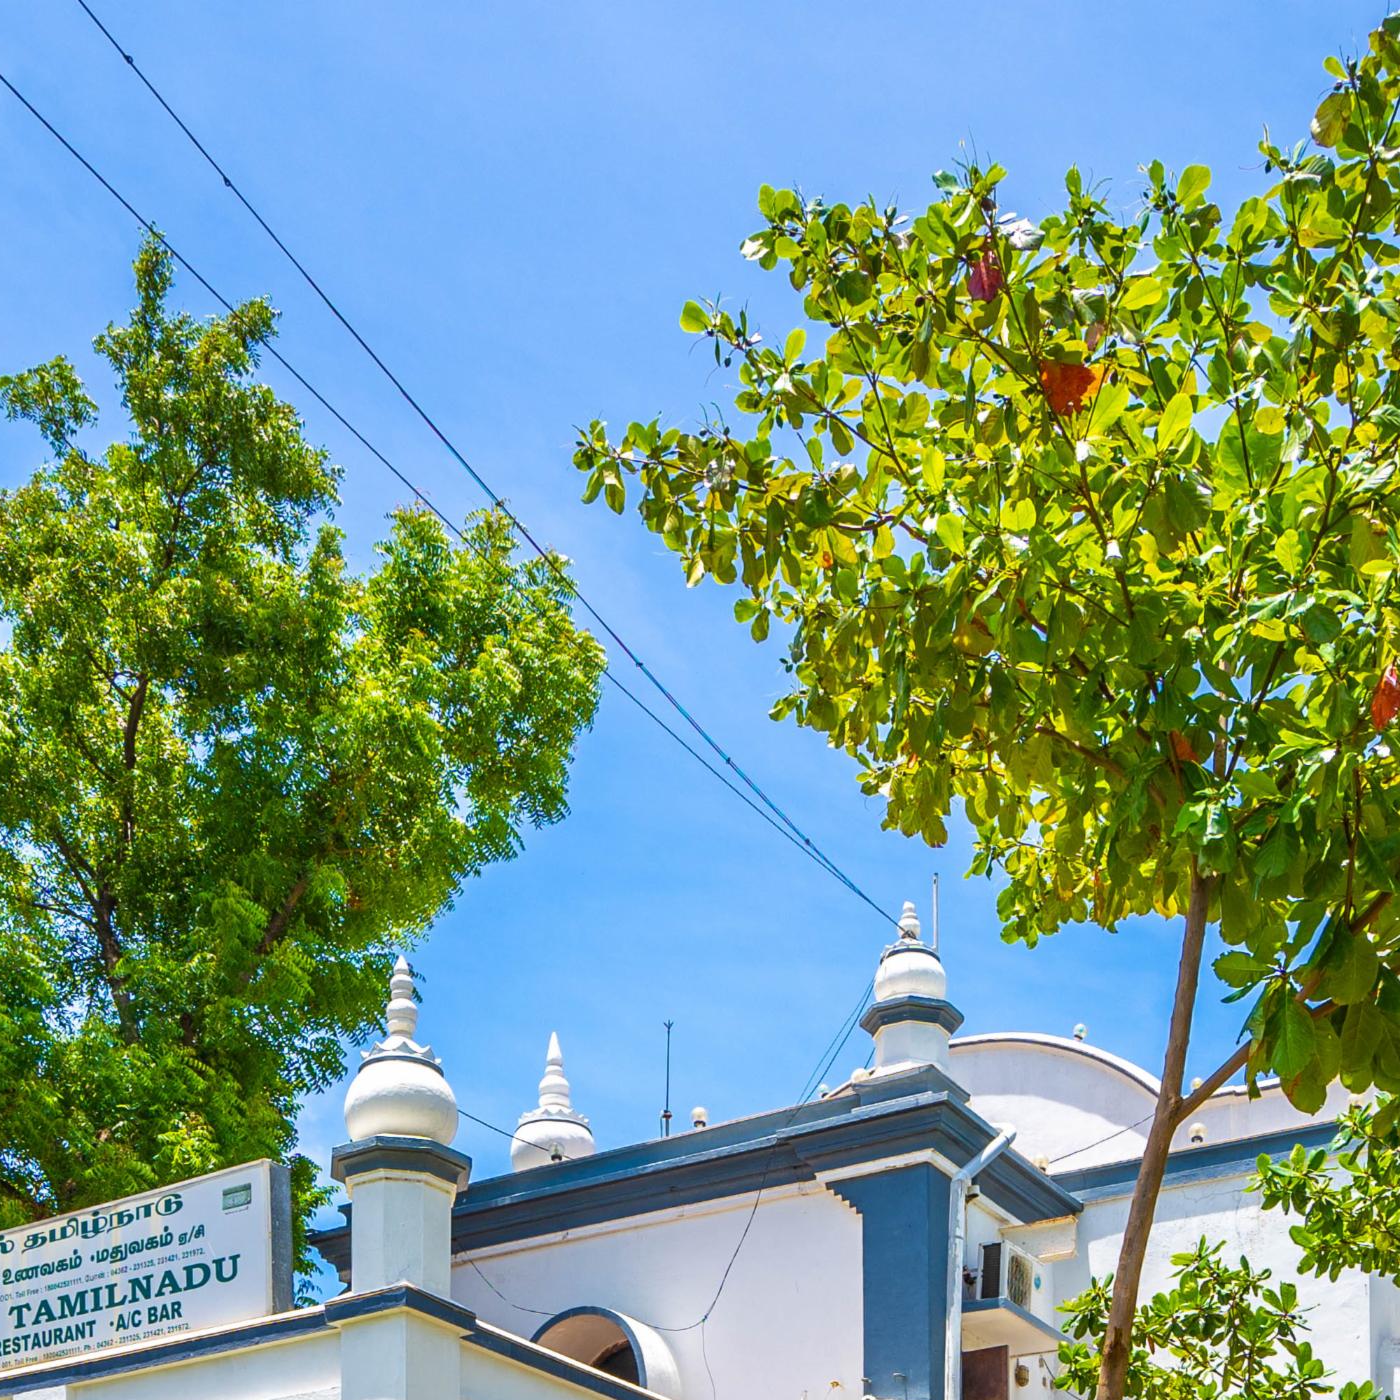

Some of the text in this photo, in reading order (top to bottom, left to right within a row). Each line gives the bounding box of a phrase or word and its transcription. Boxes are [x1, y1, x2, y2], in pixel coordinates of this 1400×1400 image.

[21, 1193, 183, 1254] தமிழ்நாடு
[2, 1249, 82, 1285] உணவகம்
[96, 1226, 173, 1265] மதுவகம்
[8, 1254, 241, 1329] TAMILNADU
[147, 1300, 183, 1325] BAR
